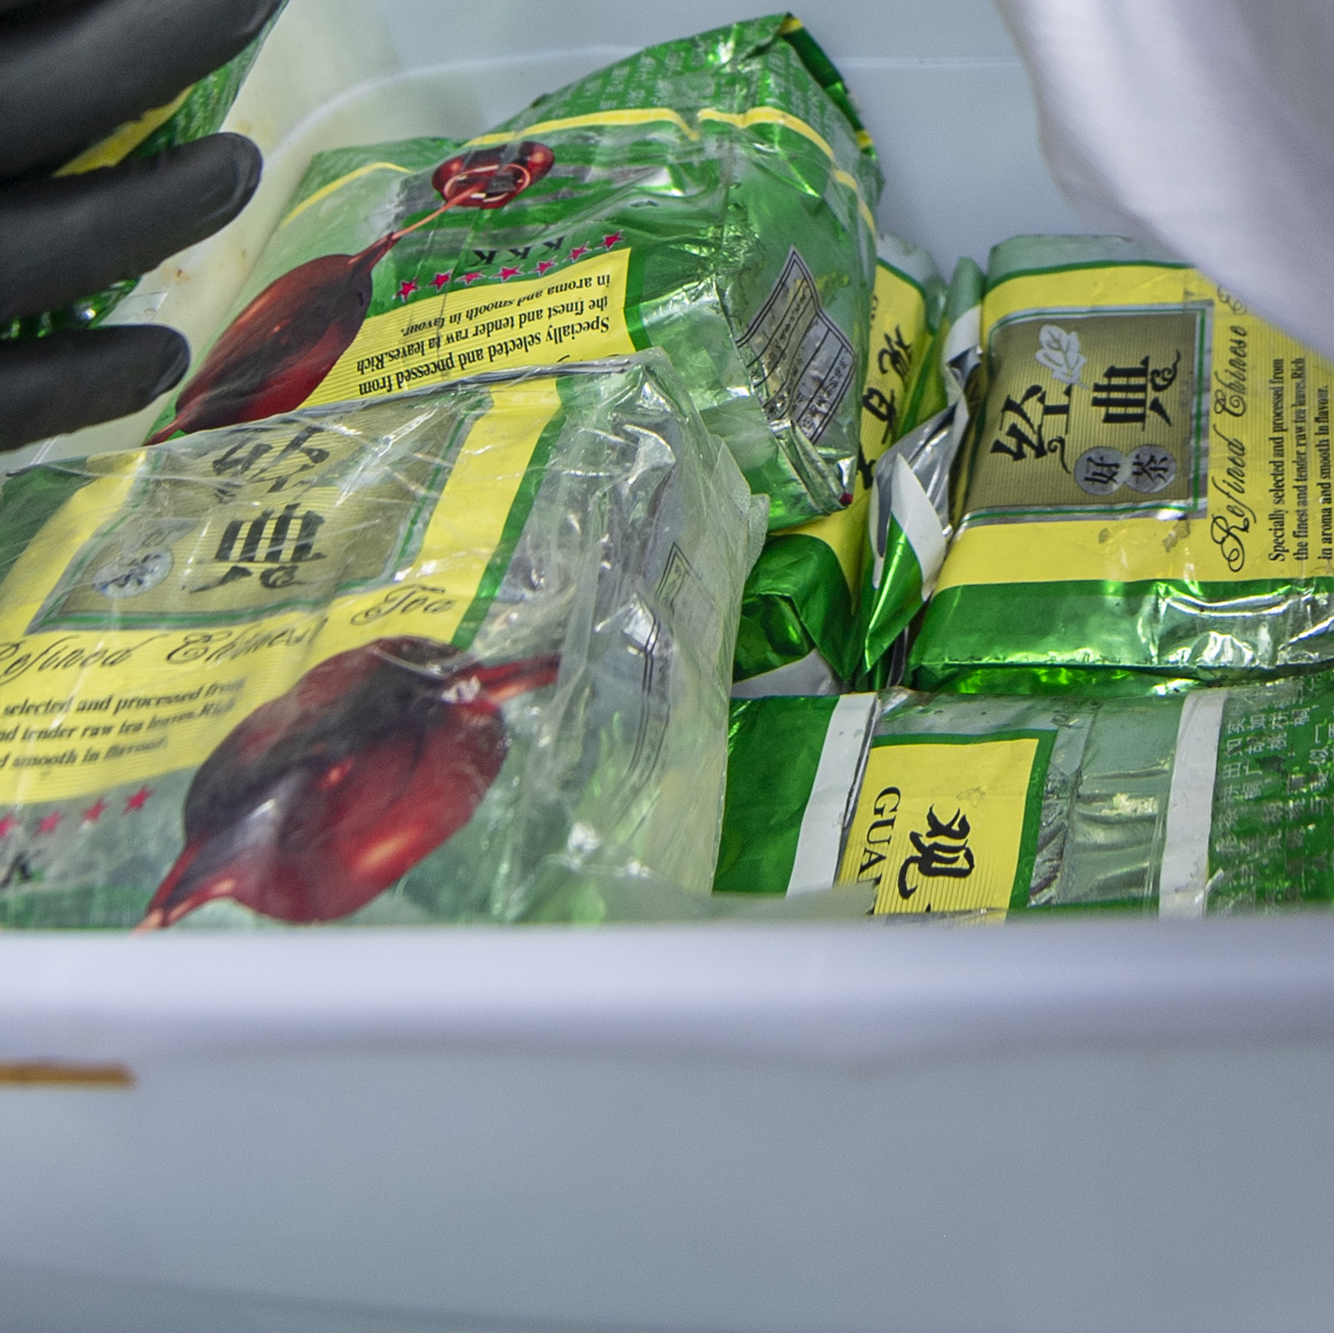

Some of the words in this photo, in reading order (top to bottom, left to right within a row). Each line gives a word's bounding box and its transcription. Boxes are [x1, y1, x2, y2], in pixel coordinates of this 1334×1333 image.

[547, 277, 593, 297] aroma
[596, 274, 611, 290] in
[465, 297, 514, 322] smooth
[517, 288, 543, 308] and
[547, 299, 585, 319] finest
[588, 295, 609, 311] the
[447, 309, 463, 326] in
[472, 314, 516, 339] tender
[518, 305, 543, 324] and
[445, 328, 471, 346] raw
[546, 316, 611, 345] Specially
[459, 344, 485, 367] and
[488, 330, 543, 358] selected
[1213, 324, 1248, 418] Chinese
[1268, 357, 1284, 384] from
[358, 374, 394, 397] from
[1268, 386, 1288, 433] processed
[1292, 408, 1307, 423] tea
[1313, 384, 1330, 424] flavour.
[1293, 425, 1307, 447] raw
[1314, 424, 1330, 436] in
[1268, 435, 1285, 457] and
[1315, 438, 1331, 479] smooth
[1084, 453, 1169, 486] 好茶
[1291, 449, 1308, 482] tender
[1268, 460, 1285, 504] selected
[1316, 481, 1332, 504] and
[1211, 424, 1258, 572] Refined
[1292, 484, 1308, 506] and
[1267, 508, 1289, 562] Specially
[1292, 508, 1308, 538] finest
[1319, 506, 1333, 544] aroma
[1292, 541, 1309, 561] the
[1317, 546, 1333, 560] in
[350, 583, 457, 626] Tea
[2, 690, 69, 717] selected
[76, 690, 113, 713] and
[114, 687, 201, 719] processed
[21, 716, 77, 743] tender
[79, 718, 114, 740] raw
[117, 714, 145, 735] tea
[13, 744, 77, 769] smooth
[81, 745, 102, 765] in
